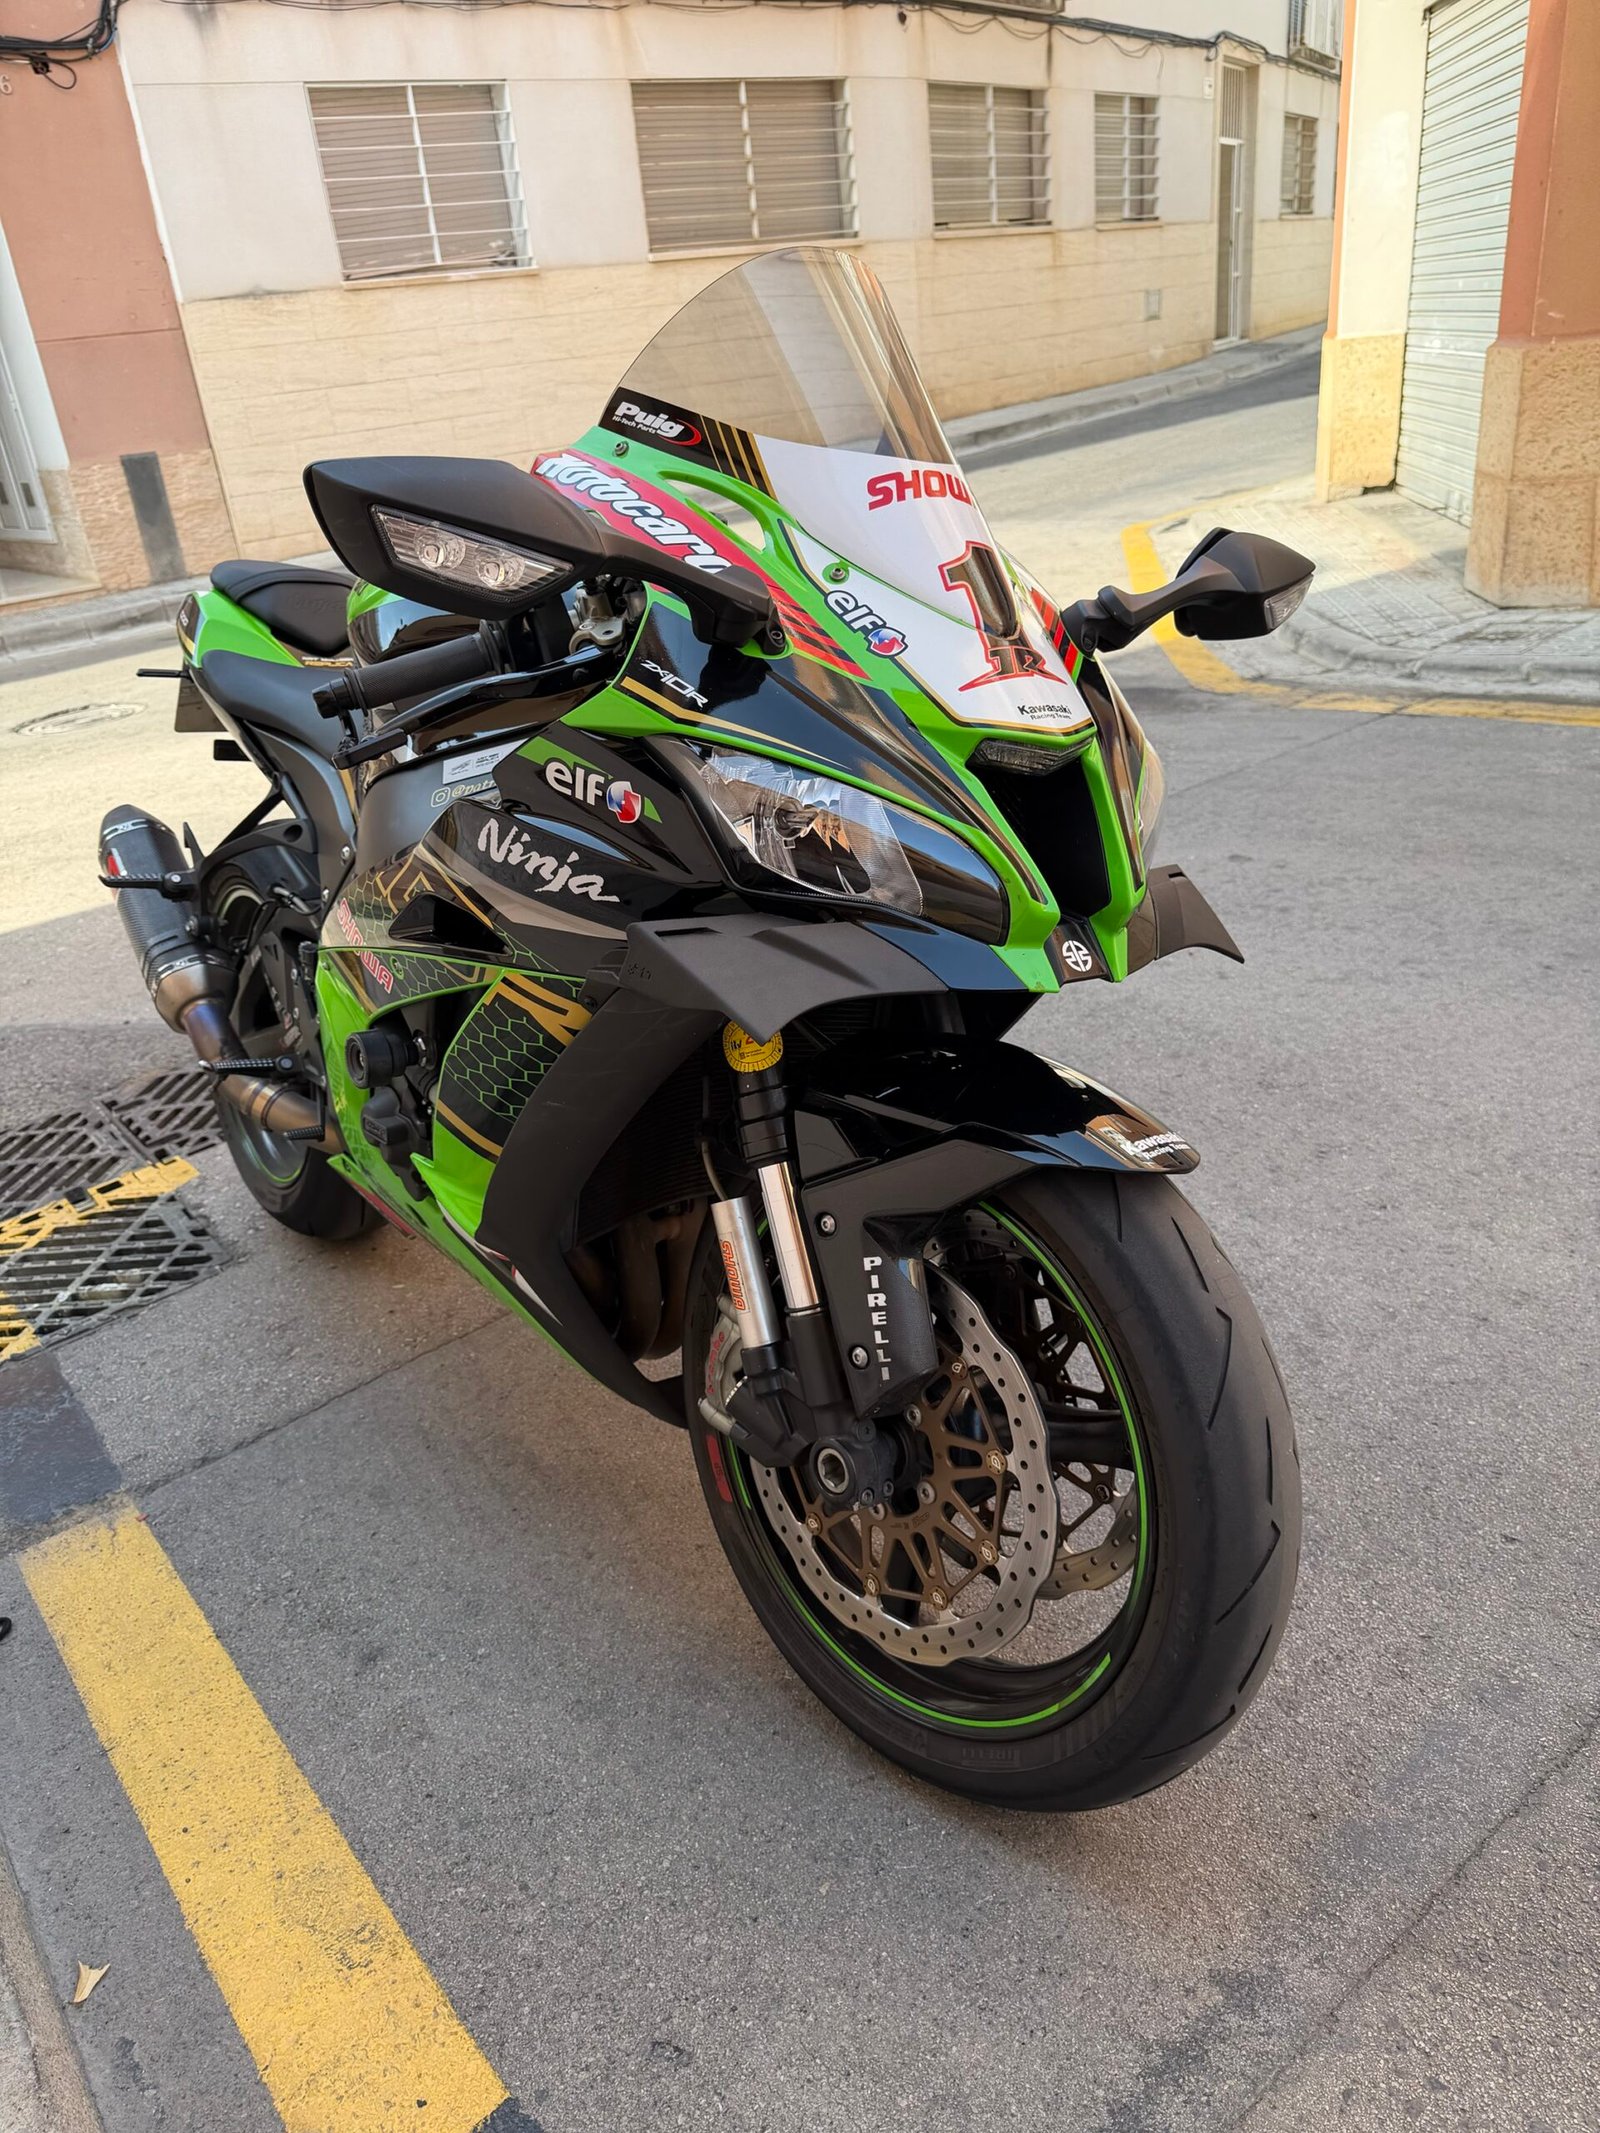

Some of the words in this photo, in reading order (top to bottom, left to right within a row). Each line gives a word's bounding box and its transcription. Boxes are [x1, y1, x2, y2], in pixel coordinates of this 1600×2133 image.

[612, 415, 637, 428] Hi-Tech
[637, 424, 658, 435] Parts
[614, 401, 684, 438] Puig
[827, 592, 886, 631] elf
[1017, 704, 1073, 716] Kawasaki
[1029, 713, 1056, 721] Racing
[545, 761, 605, 806] elf
[477, 818, 621, 903] Ninja
[337, 898, 394, 994] SHOWA
[721, 1240, 746, 1311] SHOWA
[863, 1256, 892, 1381] PIRELLI
